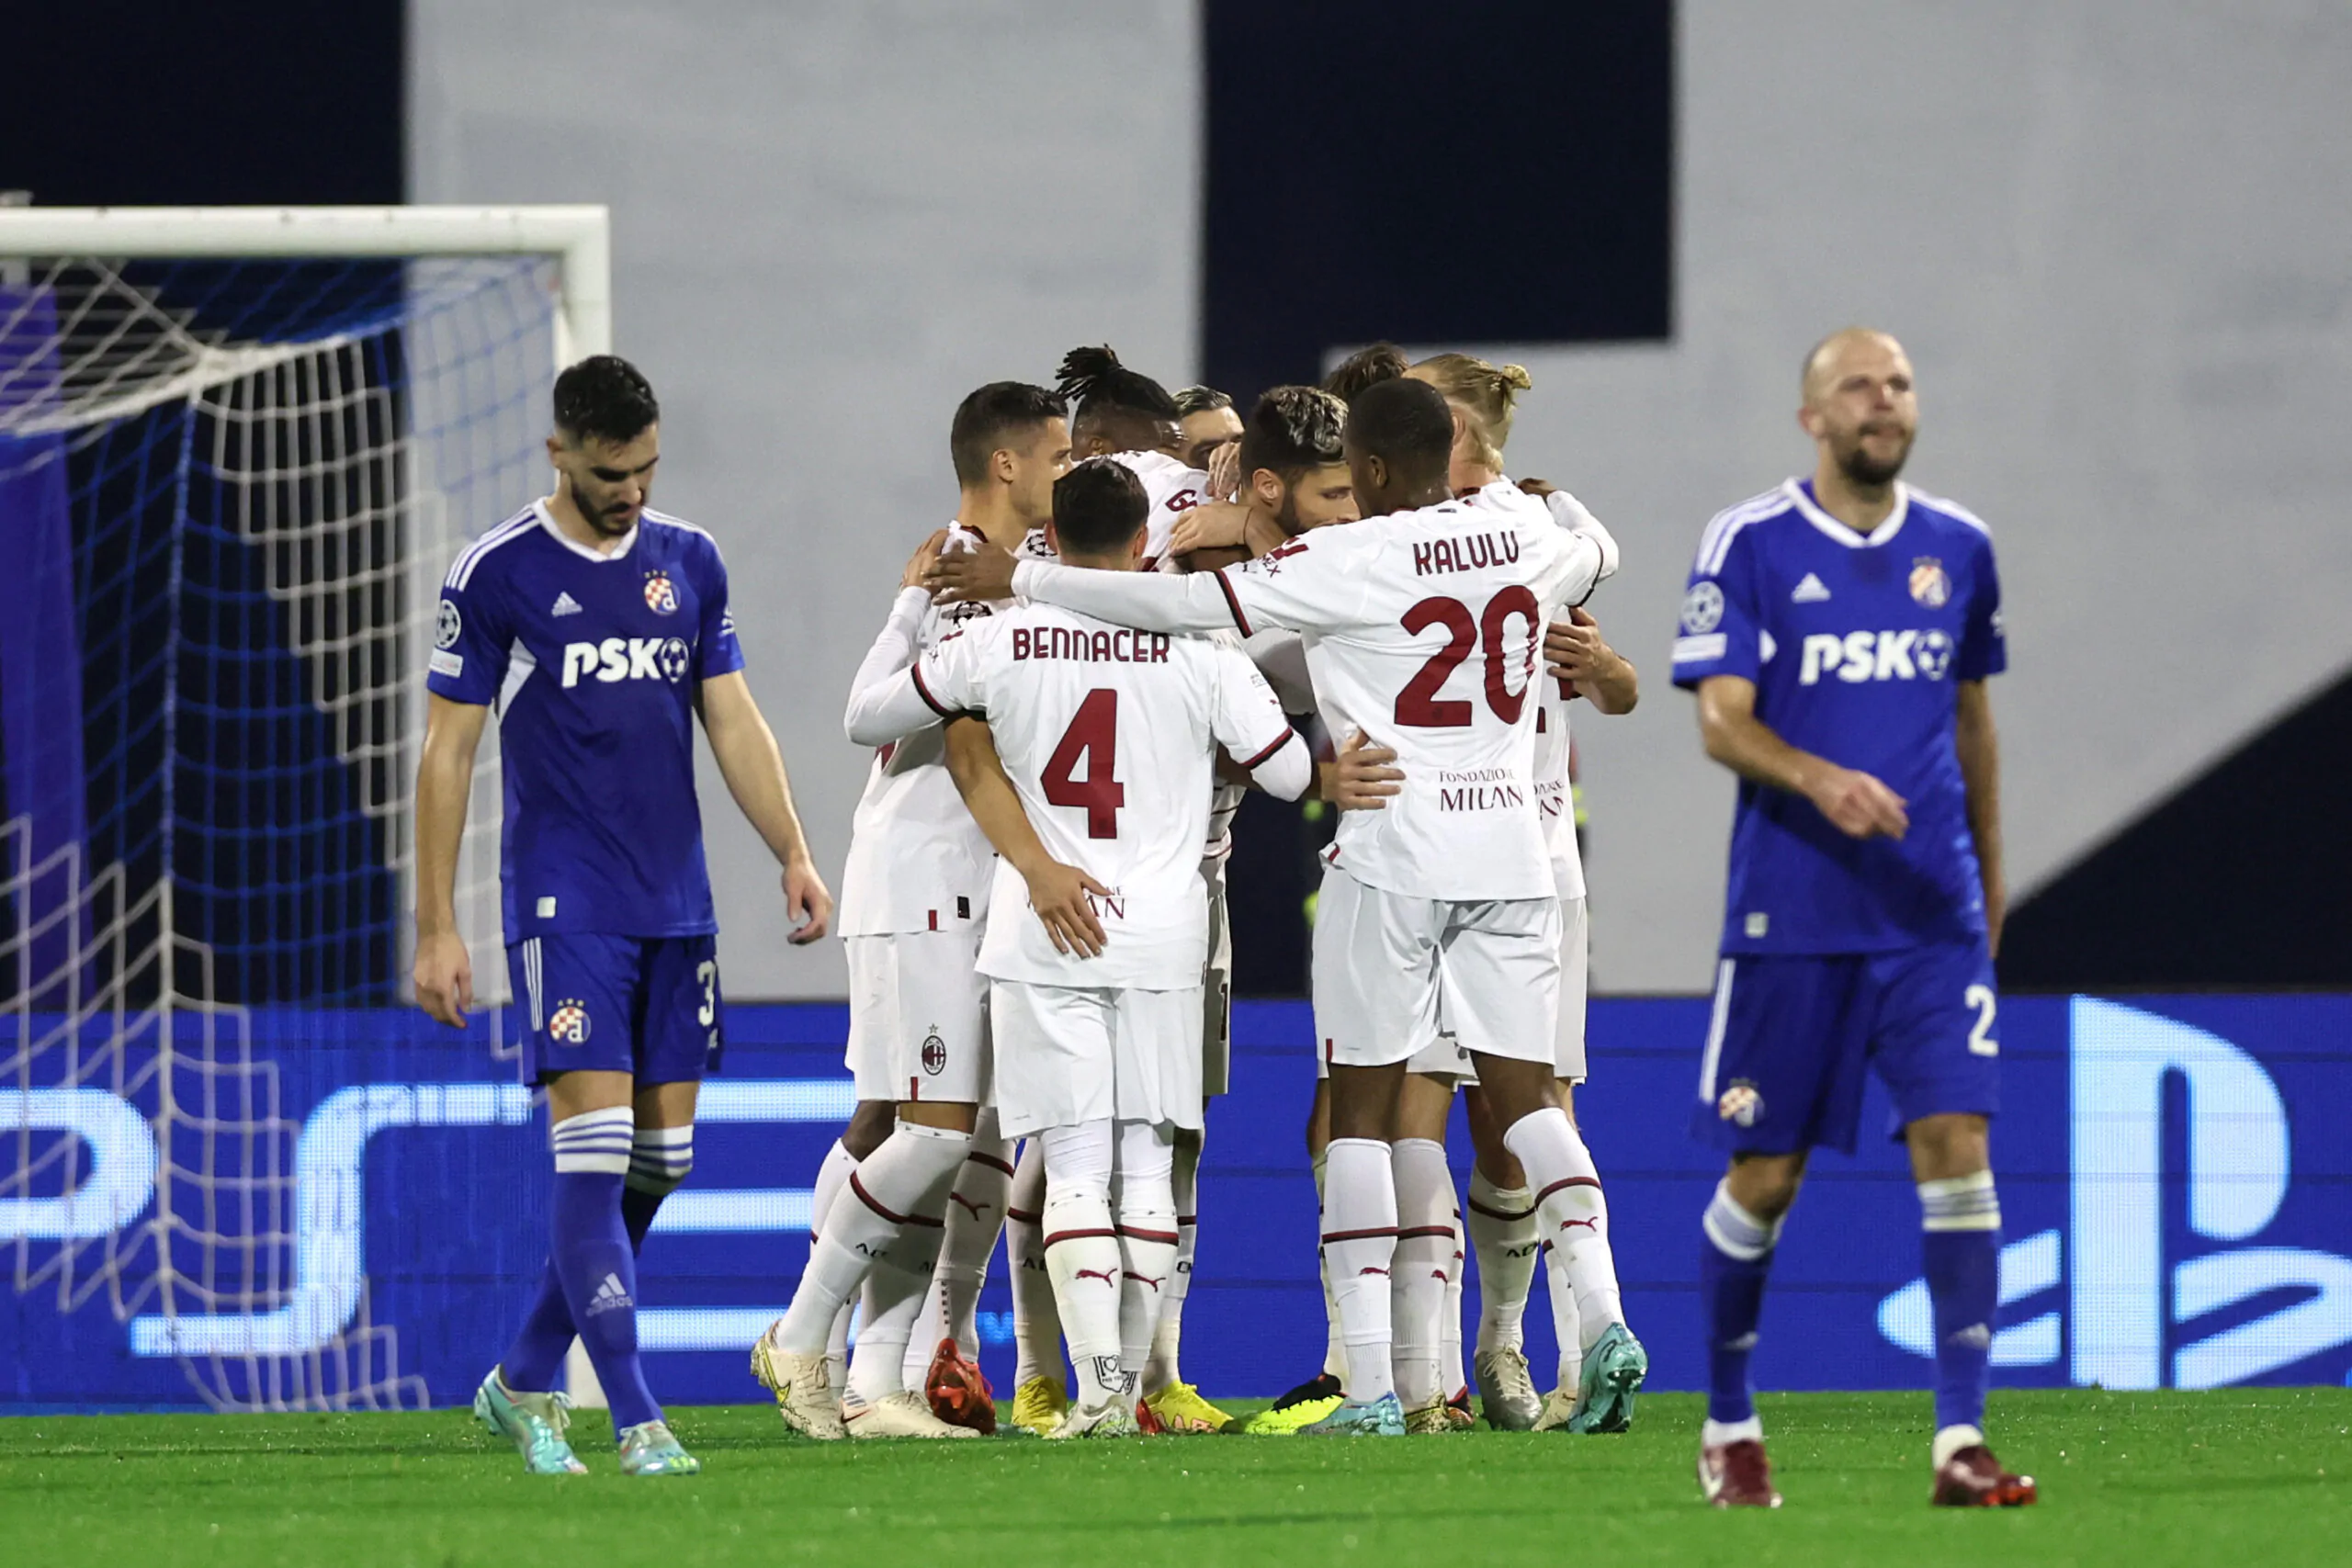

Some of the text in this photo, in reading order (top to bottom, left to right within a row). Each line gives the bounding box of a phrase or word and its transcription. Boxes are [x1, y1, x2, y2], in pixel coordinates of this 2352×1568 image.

[1412, 530, 1519, 576] KALULU
[1012, 626, 1170, 663] BENNACER
[1394, 584, 1539, 728] 20
[1040, 688, 1125, 840] 4
[1440, 784, 1524, 812] MILAN
[1965, 985, 1999, 1056] 2
